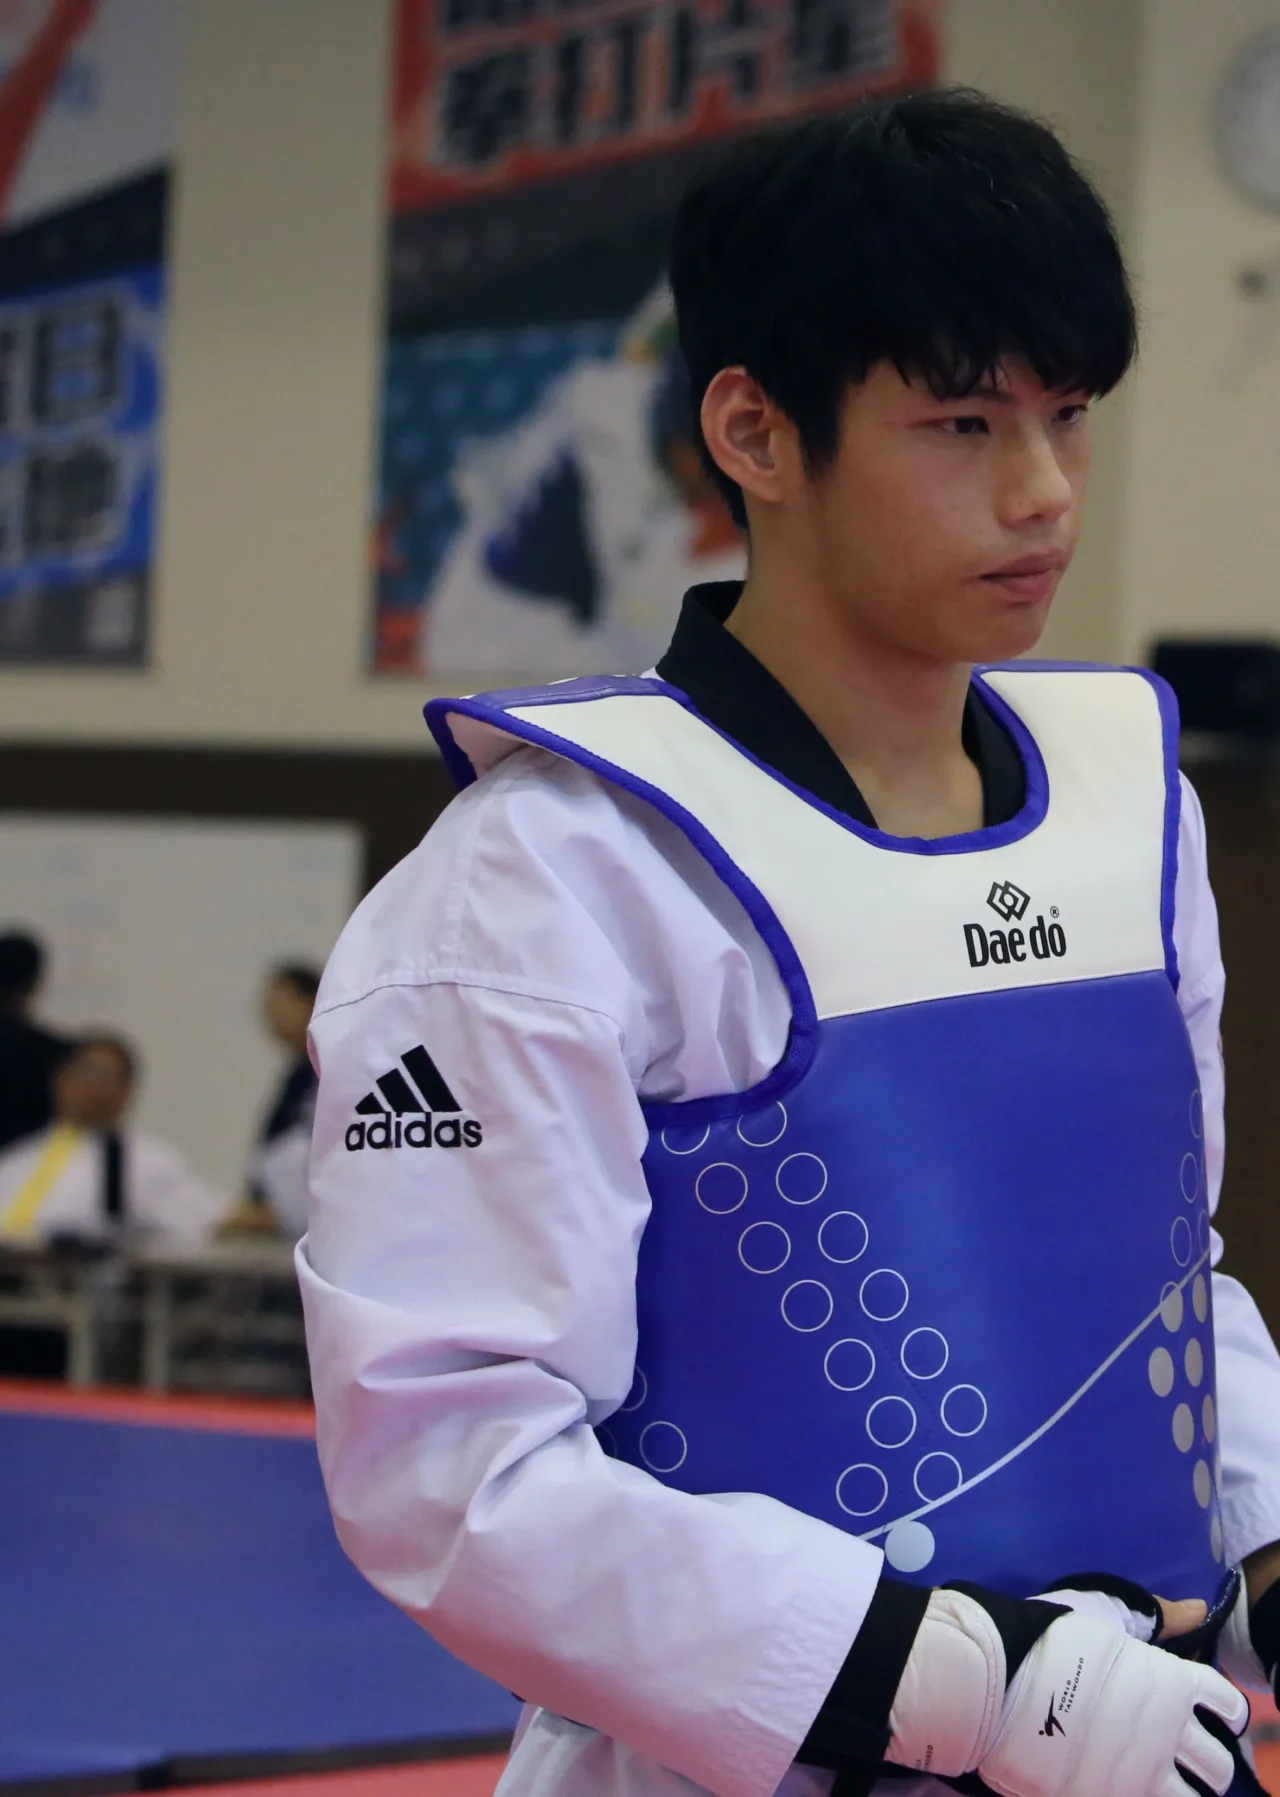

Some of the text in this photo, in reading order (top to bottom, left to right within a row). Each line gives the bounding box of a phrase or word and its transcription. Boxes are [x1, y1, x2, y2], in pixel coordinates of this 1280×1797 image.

[345, 1110, 483, 1152] adidas
[1058, 1679, 1072, 1711] WORLD
[1064, 1657, 1084, 1713] TAEKWONDO
